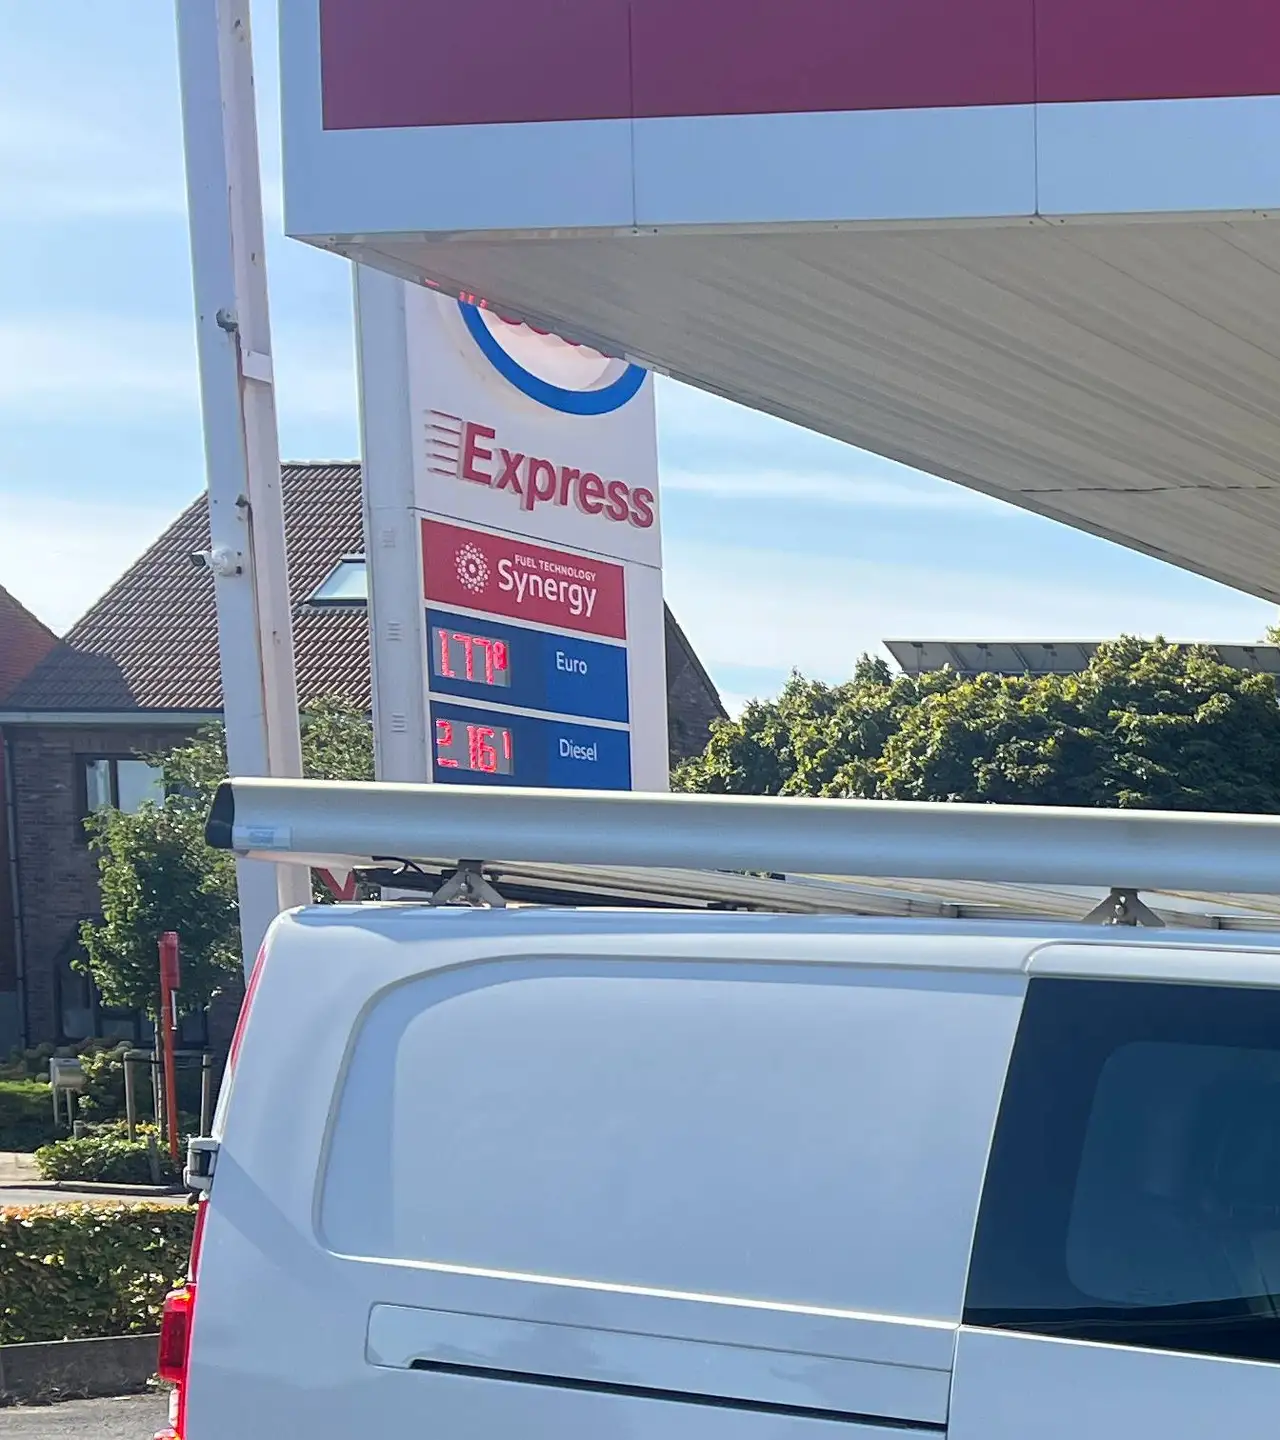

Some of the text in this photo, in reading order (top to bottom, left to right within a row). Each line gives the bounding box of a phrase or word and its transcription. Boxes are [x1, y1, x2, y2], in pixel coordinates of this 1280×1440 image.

[460, 421, 654, 528] Express
[514, 553, 597, 582] FUEL TECHNOLOGY
[497, 558, 597, 618] Synergy
[555, 651, 588, 675] Euro
[559, 738, 598, 762] Diesel
